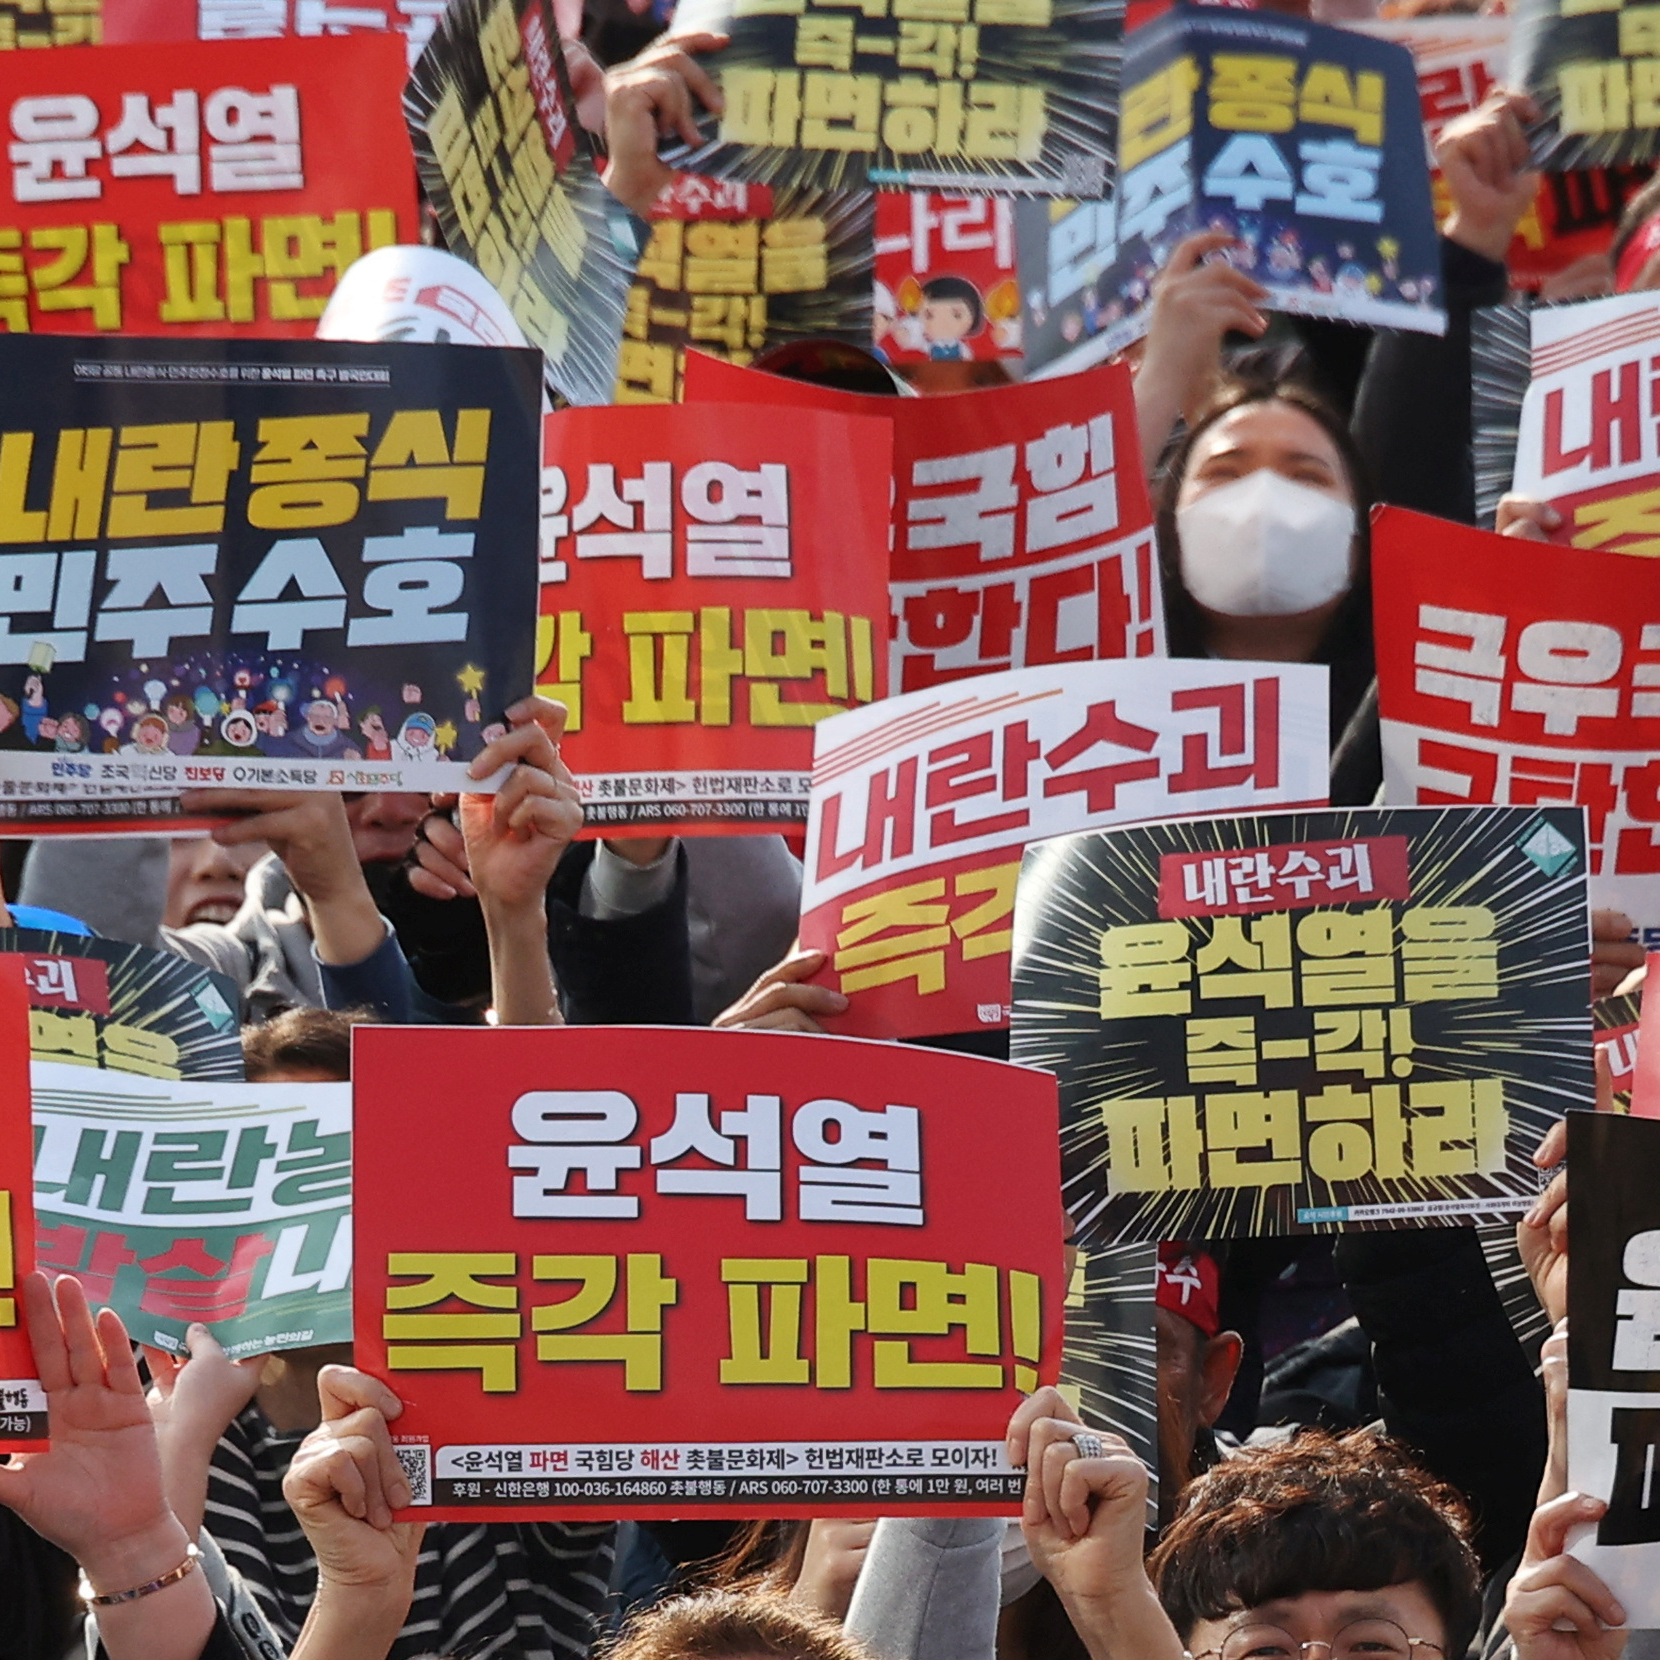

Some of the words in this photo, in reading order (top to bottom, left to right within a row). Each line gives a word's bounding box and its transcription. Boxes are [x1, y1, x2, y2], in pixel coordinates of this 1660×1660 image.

[795, 16, 982, 79] 즉-각!
[7, 85, 304, 203] 윤석열
[1207, 52, 1387, 148] 종식
[1203, 132, 1388, 224] 수호
[245, 408, 492, 532] 종식
[229, 526, 477, 653] 수호
[638, 802, 662, 818] ARS
[692, 776, 797, 798] 헌법재판소로
[814, 676, 1281, 887] 내란수괴
[1181, 841, 1374, 907] 내란수괴
[1096, 905, 1500, 1021] 윤석열을
[1185, 1007, 1415, 1087] 즉-각!
[507, 1090, 926, 1227] 윤석열
[1101, 1079, 1510, 1194] 파면하라
[382, 1252, 678, 1395] 즉각
[718, 1253, 1041, 1395] 파면!
[450, 1450, 524, 1473] <윤석열
[529, 1449, 569, 1473] 파면
[574, 1449, 636, 1473] 국힘당
[640, 1448, 681, 1472] 해산
[685, 1447, 800, 1472] 촛불문화제>
[804, 1446, 924, 1470] 헌법재판소로
[929, 1446, 999, 1470] 모이자!
[452, 1481, 482, 1499] 후원
[493, 1481, 551, 1500] 신한은행
[553, 1481, 668, 1499] 100-036-164860
[669, 1480, 727, 1498] 촛불행동
[738, 1479, 769, 1496] ARS
[770, 1478, 869, 1496] 060-707-3300
[871, 1477, 892, 1497] (한
[893, 1477, 923, 1496] 통에
[926, 1477, 951, 1496] 1만
[953, 1477, 974, 1496] 원,
[975, 1477, 1004, 1495] 여러
[1006, 1477, 1023, 1496] 번
